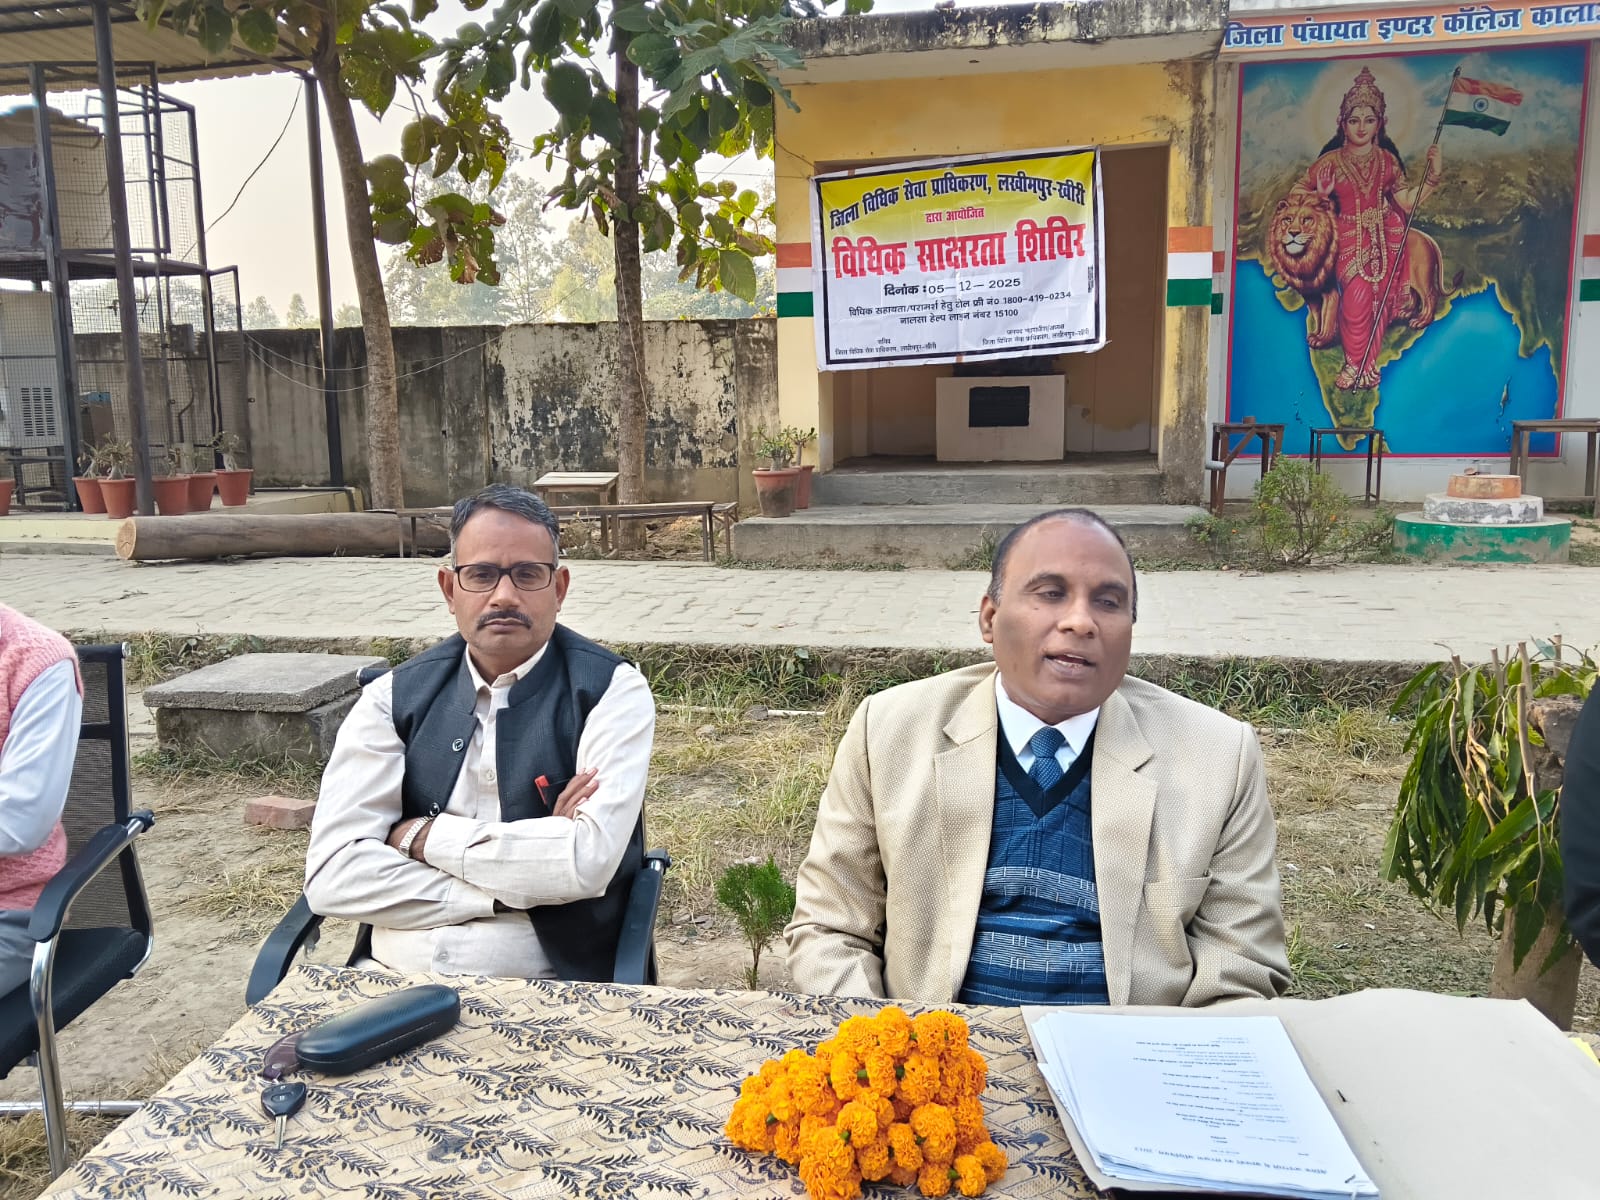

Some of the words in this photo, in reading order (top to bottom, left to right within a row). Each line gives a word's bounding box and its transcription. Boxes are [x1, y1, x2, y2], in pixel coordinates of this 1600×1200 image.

[1224, 21, 1285, 46] जिला
[1291, 17, 1369, 42] पंचायत
[1376, 15, 1435, 40] इण्टर
[1441, 6, 1522, 33] कॉलेज
[830, 202, 860, 230] जिला
[862, 187, 899, 214] विधिक
[903, 179, 927, 200] सेवा
[930, 172, 991, 196] प्राधिकरण,
[997, 171, 1085, 205] लखीमपुर-खीरी
[946, 206, 985, 221] आयोजित
[831, 235, 908, 279] विधिक
[914, 231, 1007, 273] साक्षरता
[1014, 215, 1086, 263] शिविर
[884, 283, 919, 296] दिनांक
[848, 306, 873, 317] विधिक
[940, 300, 953, 312] हेतु
[955, 298, 970, 308] टोल
[972, 296, 984, 307] फ्री
[1003, 291, 1071, 305] 1800-419-0234
[899, 315, 927, 325] नालसा
[929, 312, 946, 323] हेल्प
[972, 309, 991, 319] नंबर
[994, 309, 1019, 318] 15100
